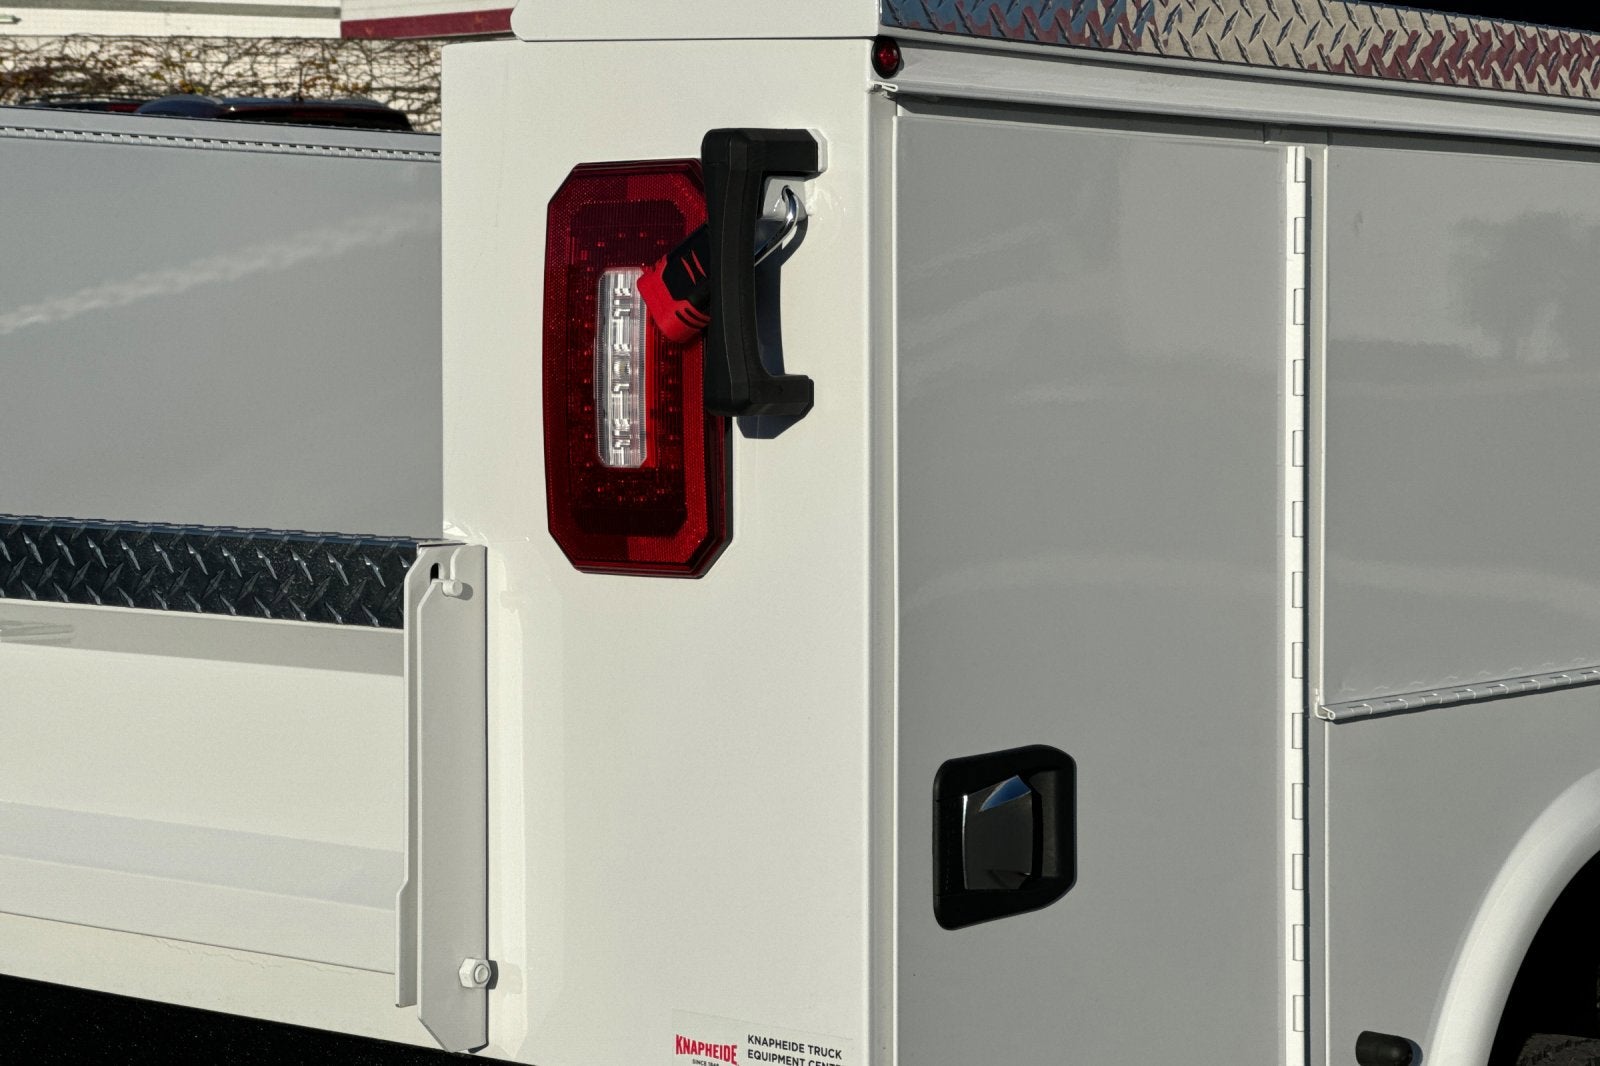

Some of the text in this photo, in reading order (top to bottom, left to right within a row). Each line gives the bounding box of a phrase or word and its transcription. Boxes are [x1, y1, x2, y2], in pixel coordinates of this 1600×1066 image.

[675, 1034, 738, 1066] KNAPHEIDE
[747, 1034, 842, 1060] KNAPHEIDE TRUCK
[747, 1049, 806, 1066] EQUIPMENT
